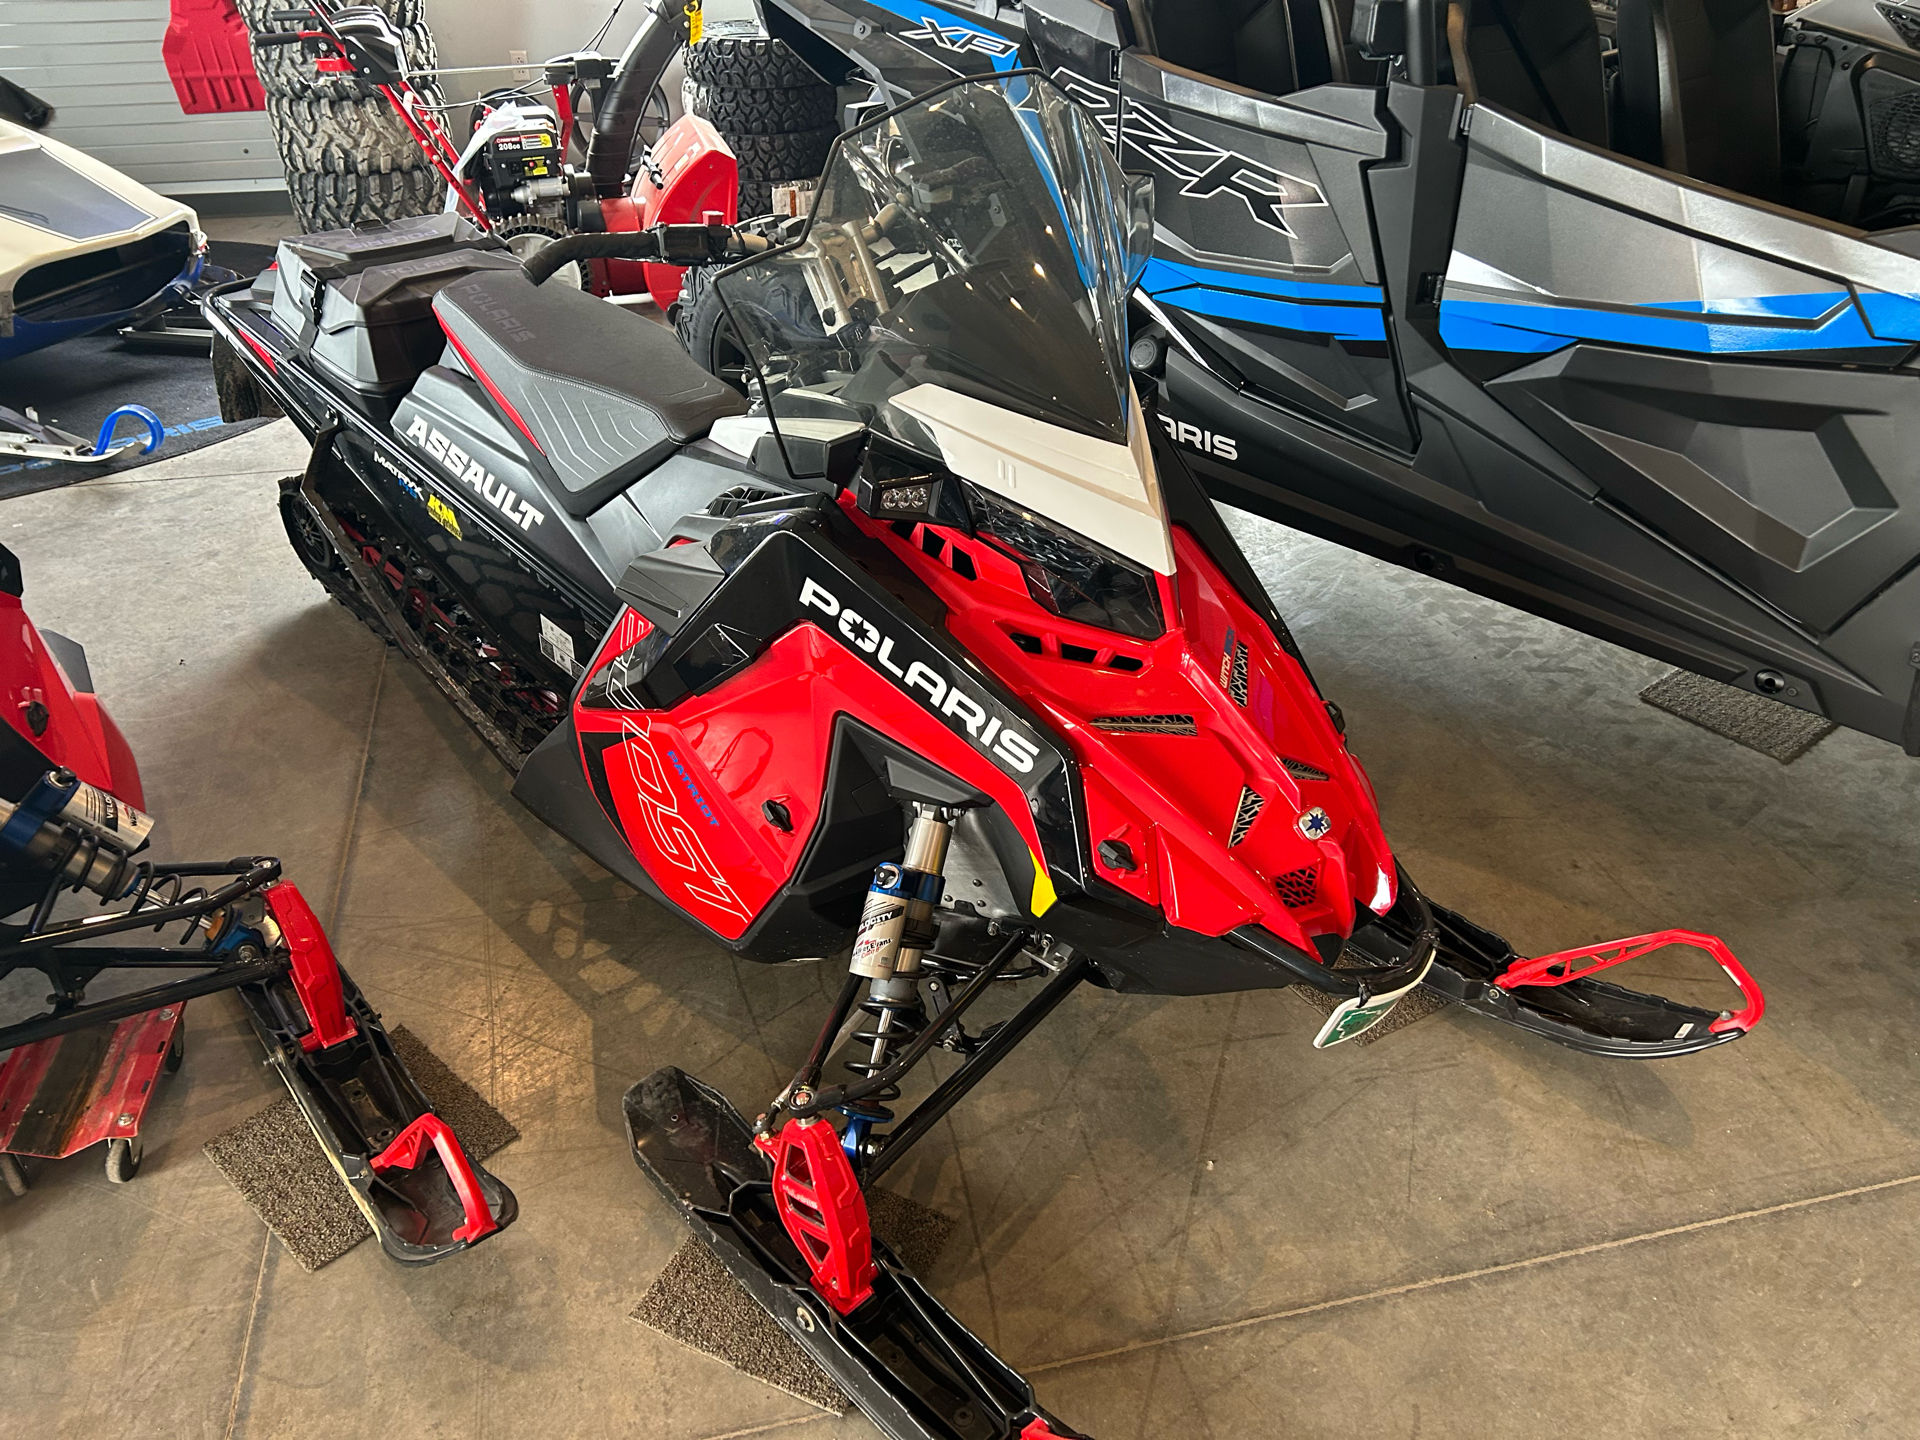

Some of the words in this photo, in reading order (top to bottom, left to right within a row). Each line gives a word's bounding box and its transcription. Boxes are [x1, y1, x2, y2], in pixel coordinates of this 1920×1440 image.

[899, 15, 1020, 58] XP
[498, 142, 521, 151] 208cc
[381, 253, 474, 277] POLARIS
[459, 284, 536, 342] POLARIS
[373, 450, 424, 502] MATRYX
[406, 414, 545, 531] ASSAULT
[799, 576, 1040, 773] POLARIS
[667, 750, 720, 827] PATRIOT
